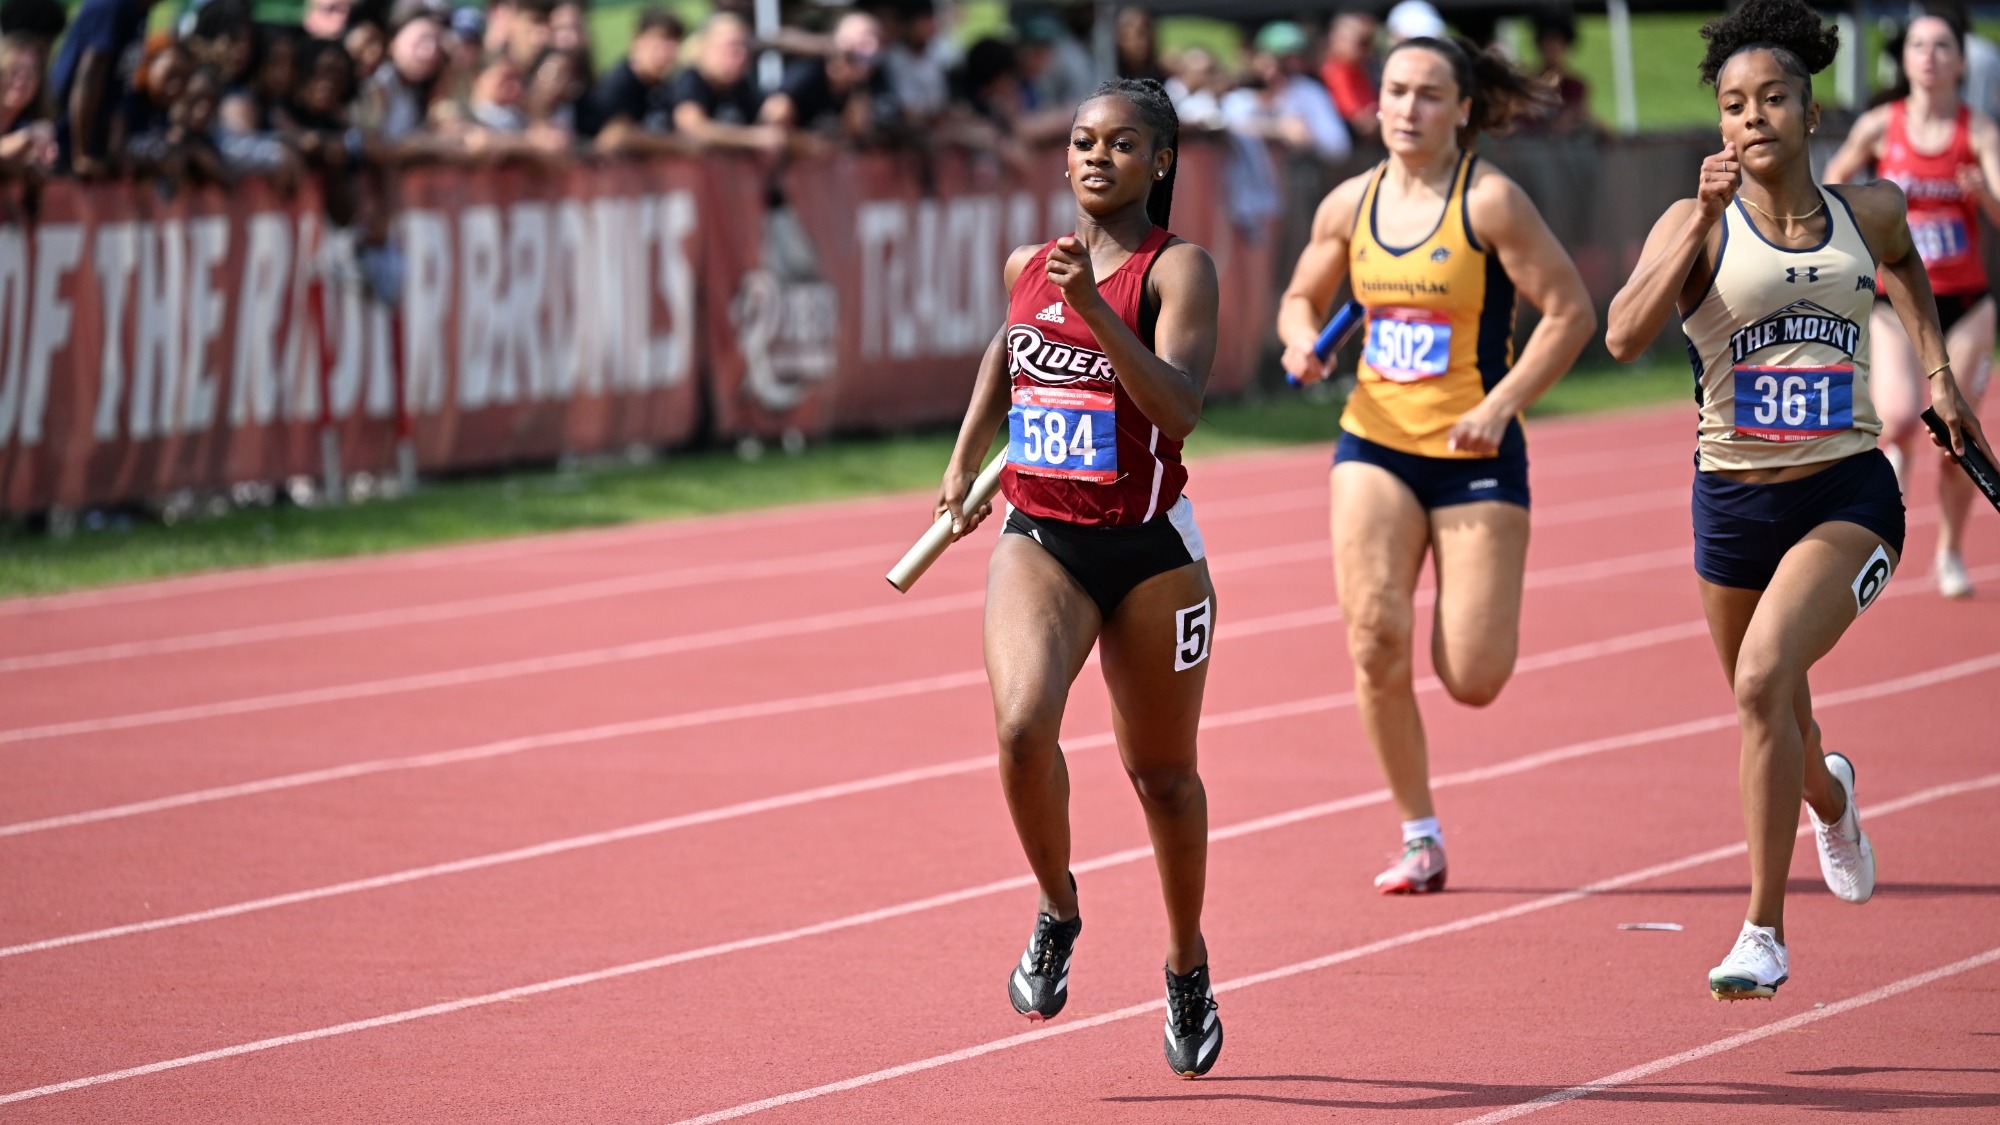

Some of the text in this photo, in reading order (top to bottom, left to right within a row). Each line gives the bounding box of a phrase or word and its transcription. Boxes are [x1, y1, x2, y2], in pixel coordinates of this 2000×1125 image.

[94, 215, 229, 442] THE
[1036, 313, 1065, 324] adidas
[1732, 317, 1858, 362] THE MOUNT
[1007, 326, 1115, 382] RIDER
[1376, 319, 1435, 372] 502
[1754, 374, 1830, 426] 361
[1023, 409, 1097, 466] 584
[1859, 558, 1888, 607] 6
[1181, 605, 1205, 663] 5
